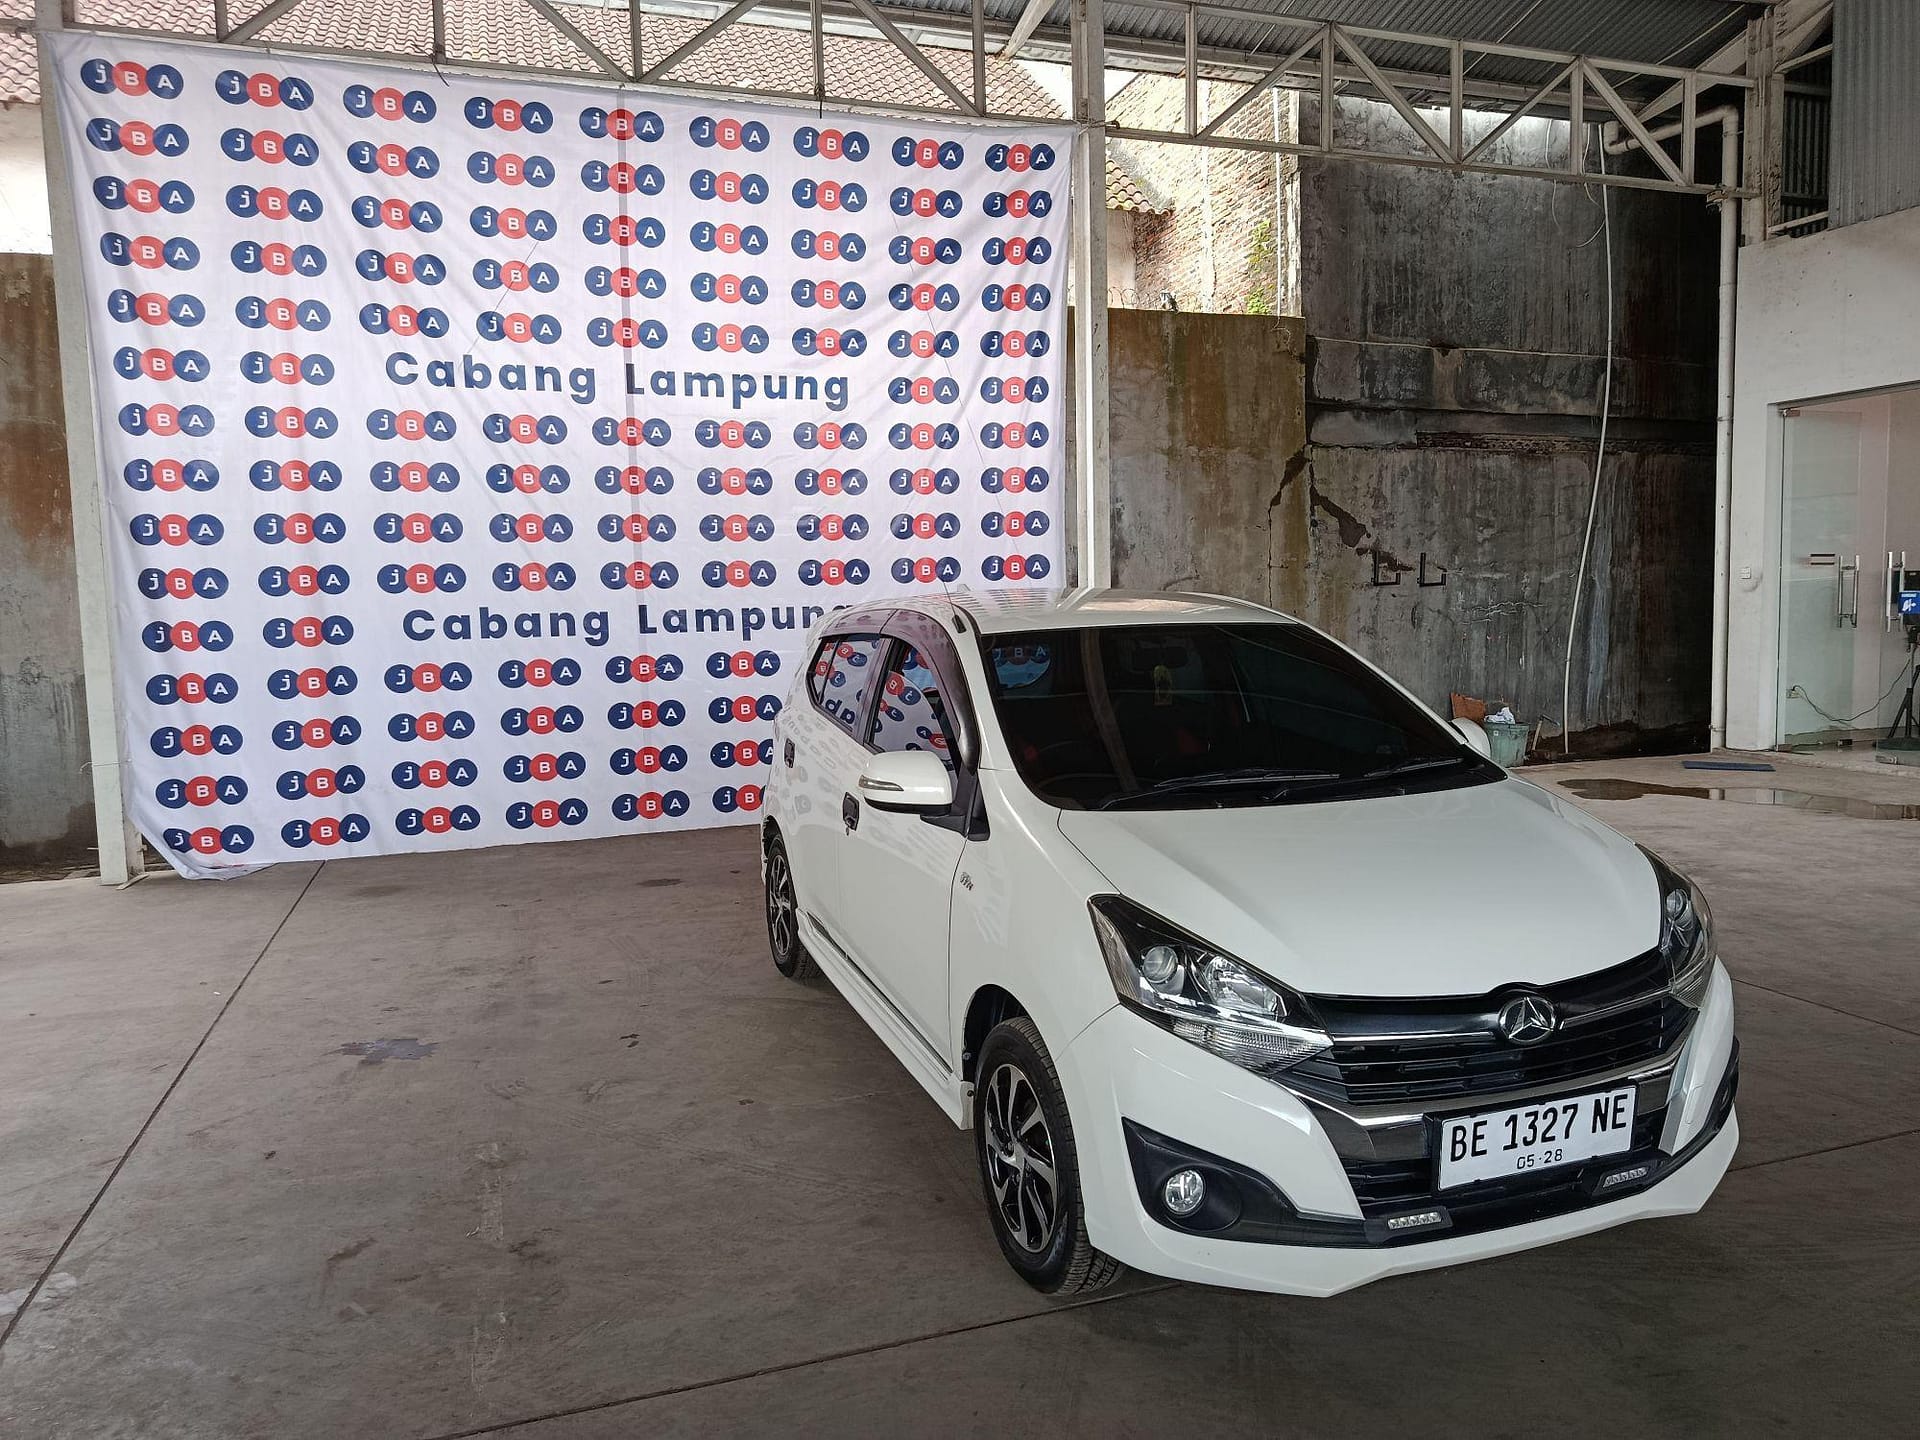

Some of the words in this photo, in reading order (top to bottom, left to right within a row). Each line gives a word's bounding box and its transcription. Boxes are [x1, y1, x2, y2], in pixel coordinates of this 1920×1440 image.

[385, 351, 596, 405] Cabang
[625, 362, 849, 412] Lampung
[402, 606, 610, 647] Cabang
[637, 604, 853, 642] Lampun
[1450, 1119, 1488, 1163] BE
[1502, 1103, 1580, 1152] 1327
[1591, 1093, 1629, 1135] NE
